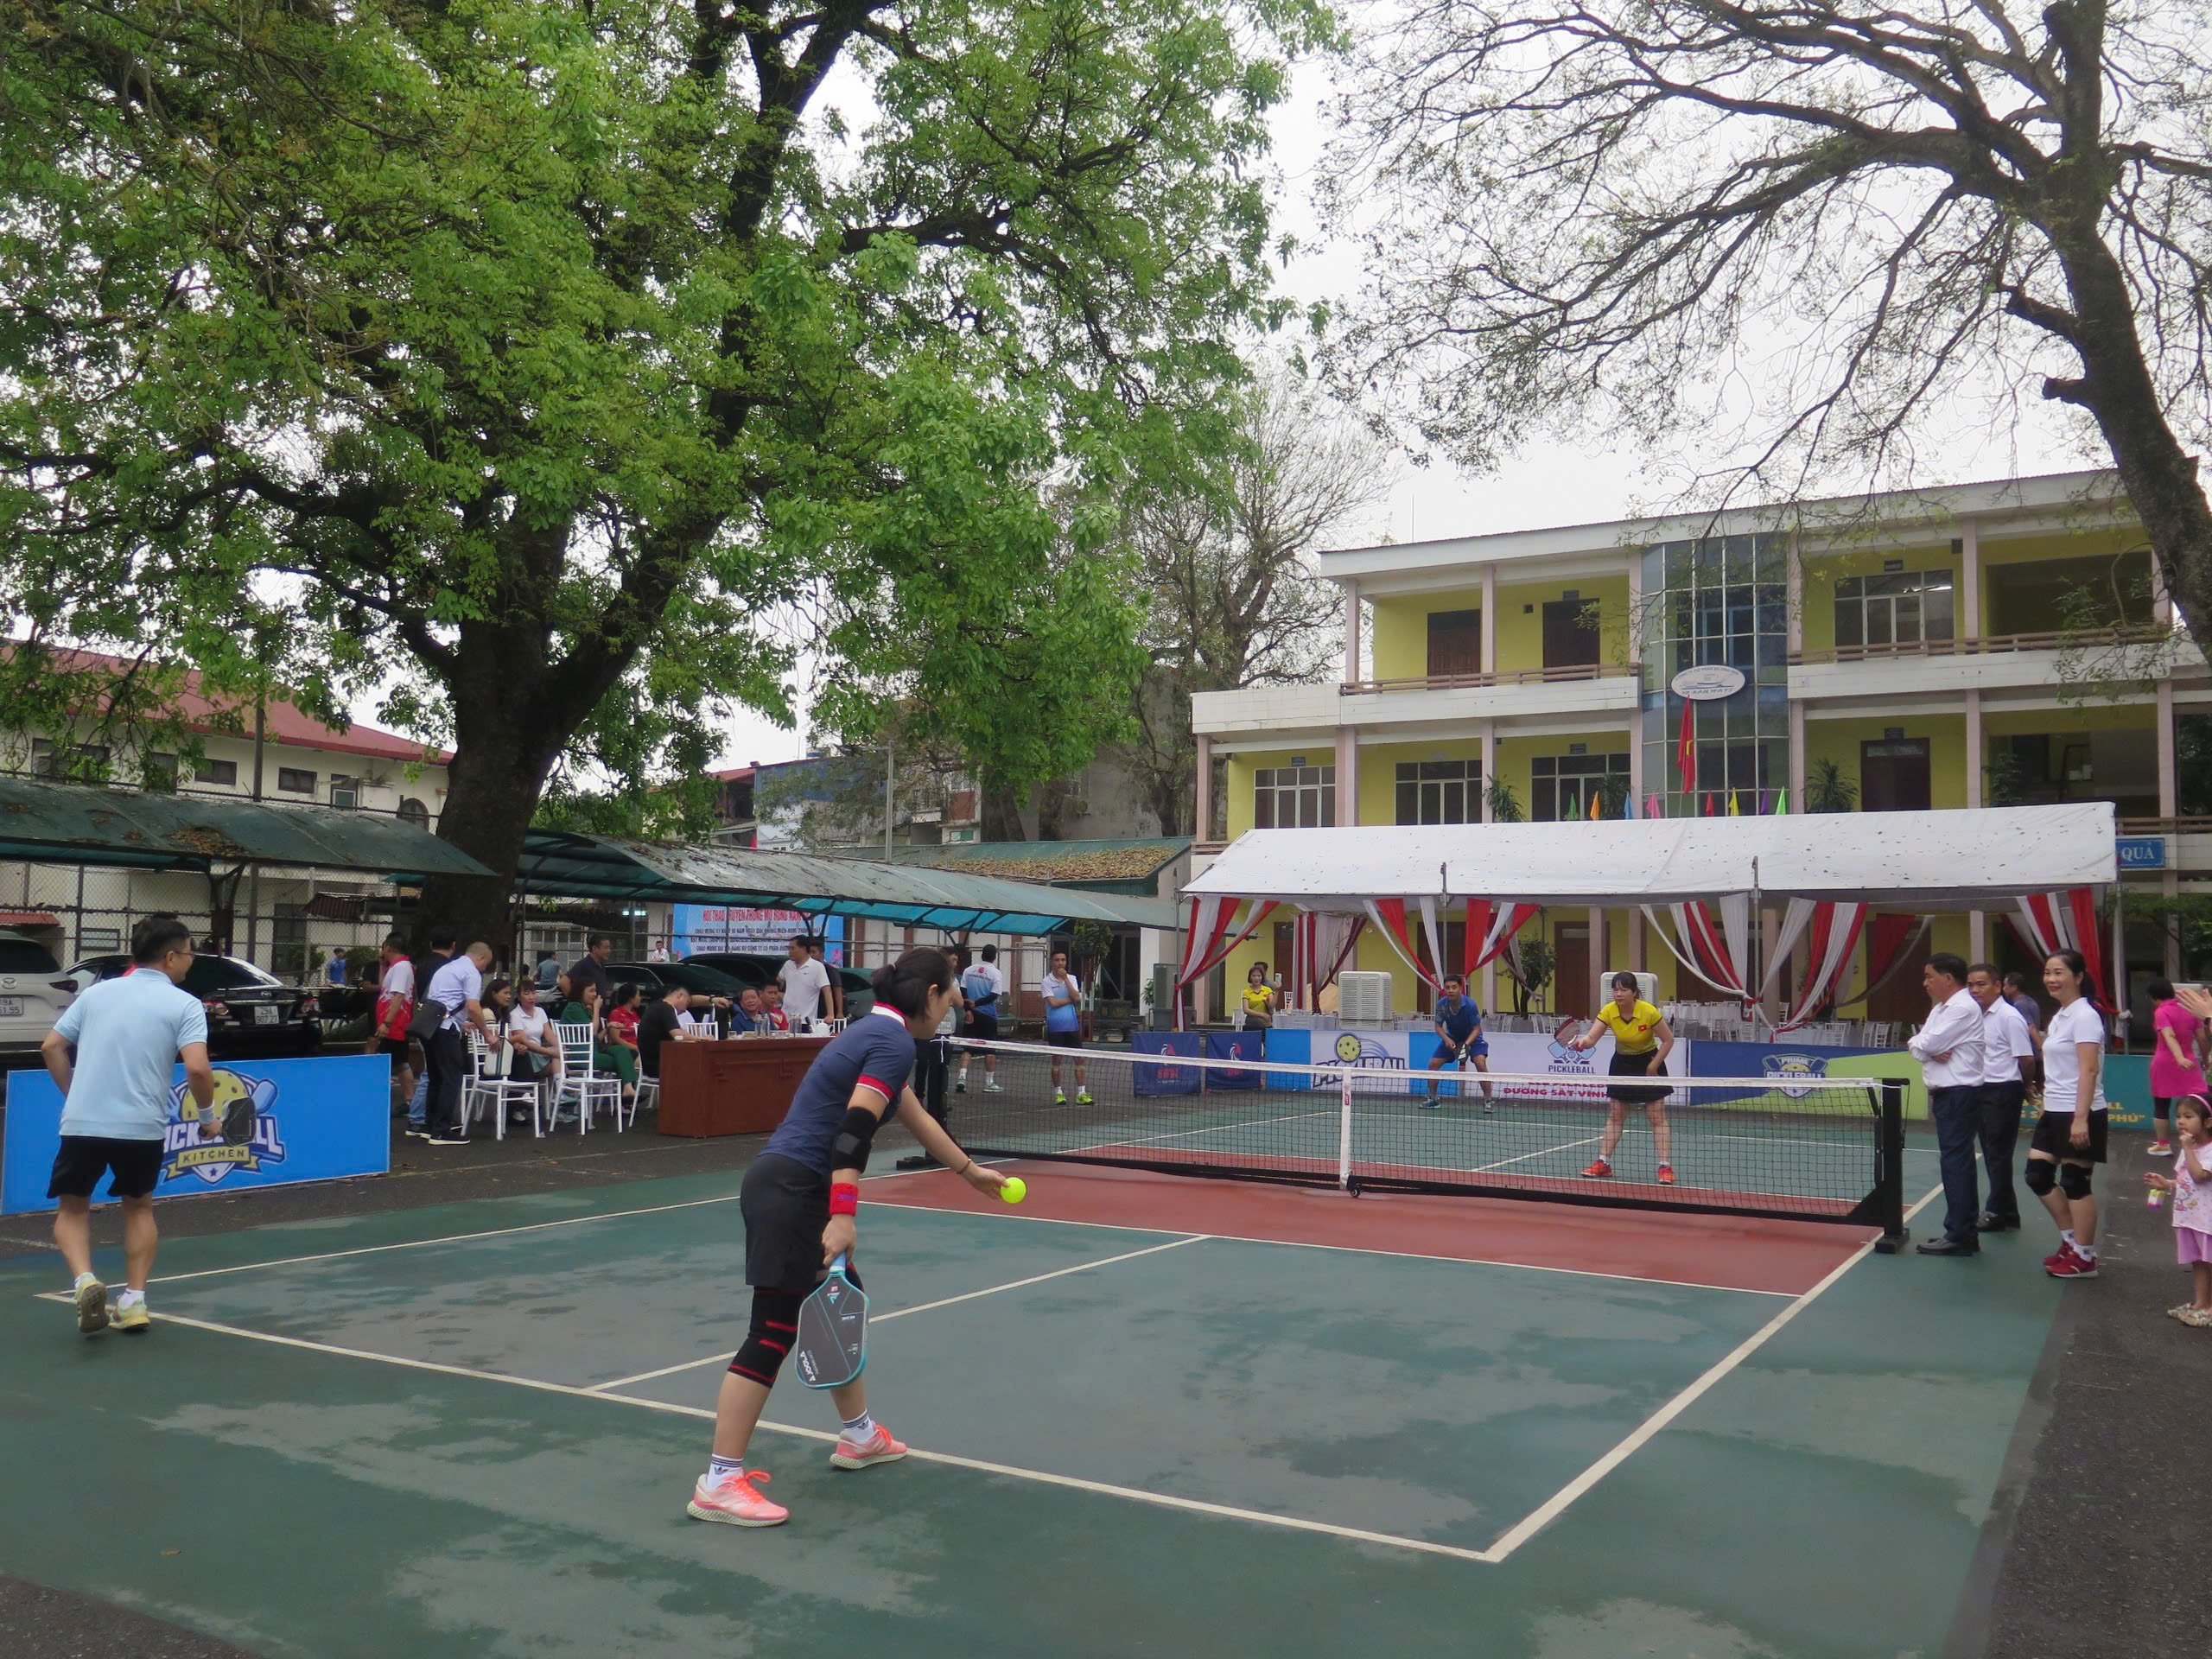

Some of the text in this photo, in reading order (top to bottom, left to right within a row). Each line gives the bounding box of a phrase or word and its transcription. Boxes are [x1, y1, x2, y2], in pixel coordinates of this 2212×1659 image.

[1548, 1064, 1596, 1074] PICKLEBALL
[182, 1147, 245, 1163] KITCHEN
[800, 1350, 814, 1376] JOOLA
